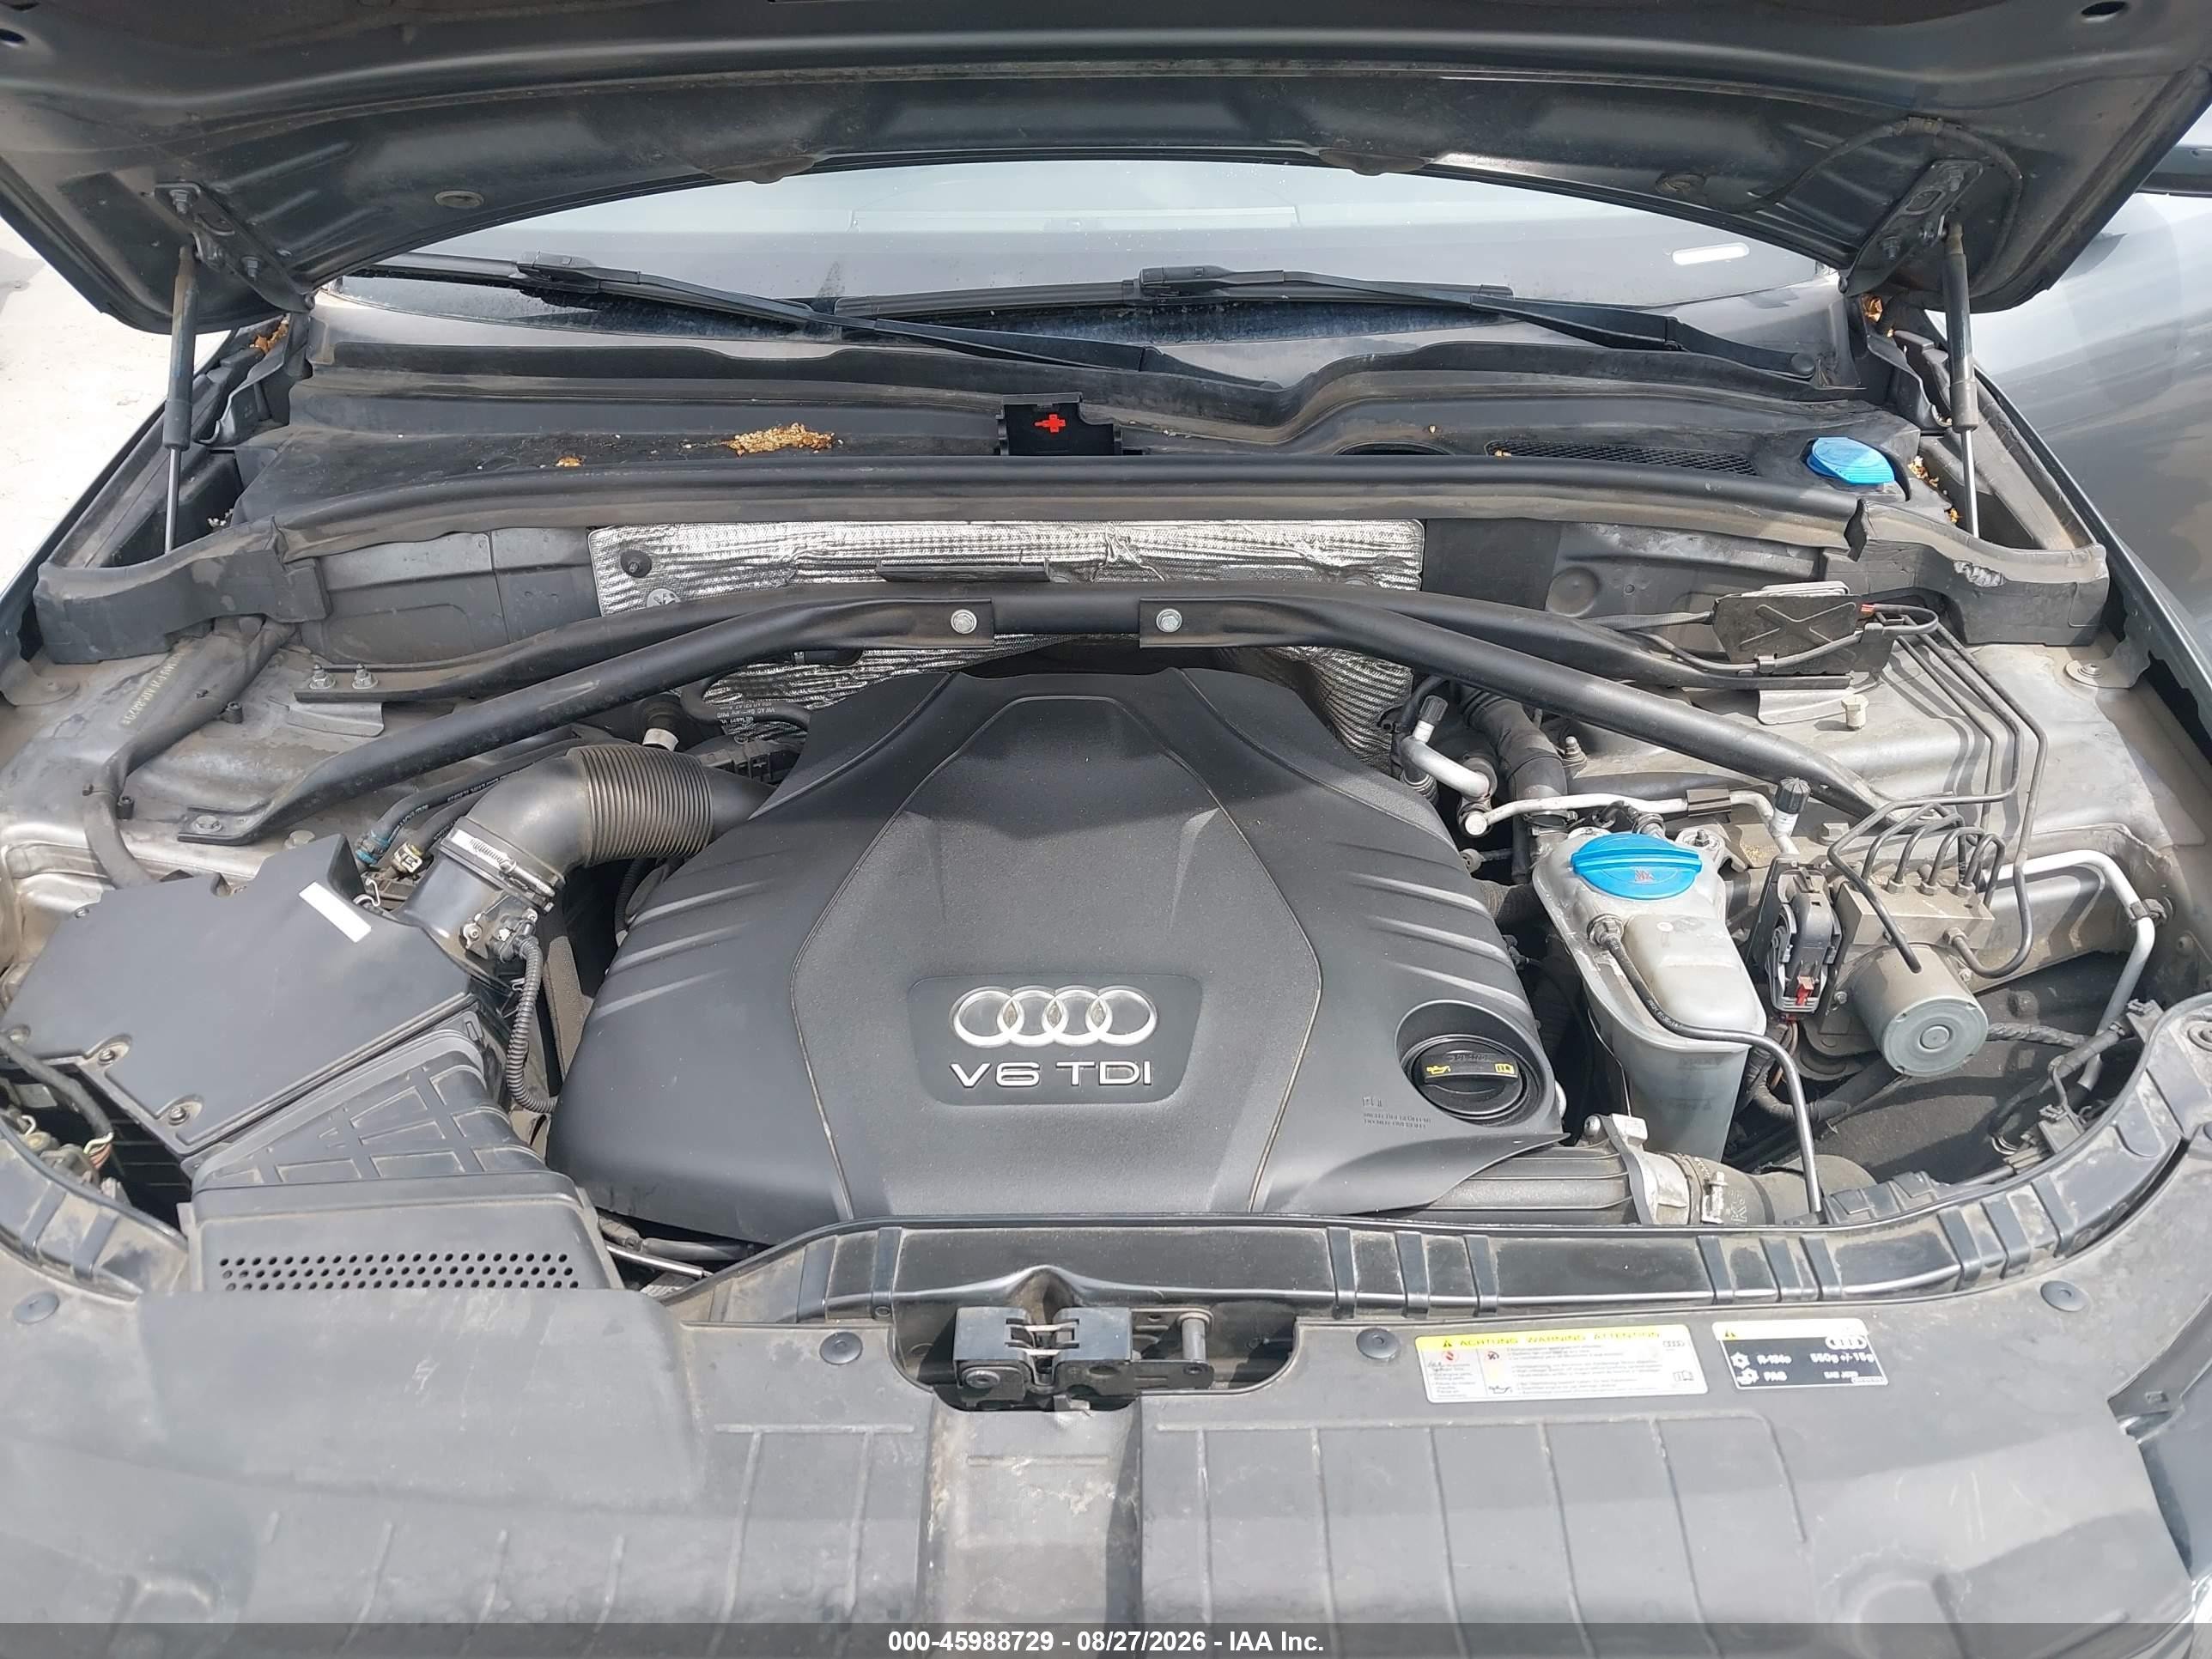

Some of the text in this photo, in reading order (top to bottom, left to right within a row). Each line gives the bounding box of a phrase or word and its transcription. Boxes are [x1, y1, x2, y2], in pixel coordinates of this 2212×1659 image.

[949, 1060, 1153, 1088] V6 TDI
[1459, 1331, 1661, 1347] ACHTUNG WARNING ATTENTION
